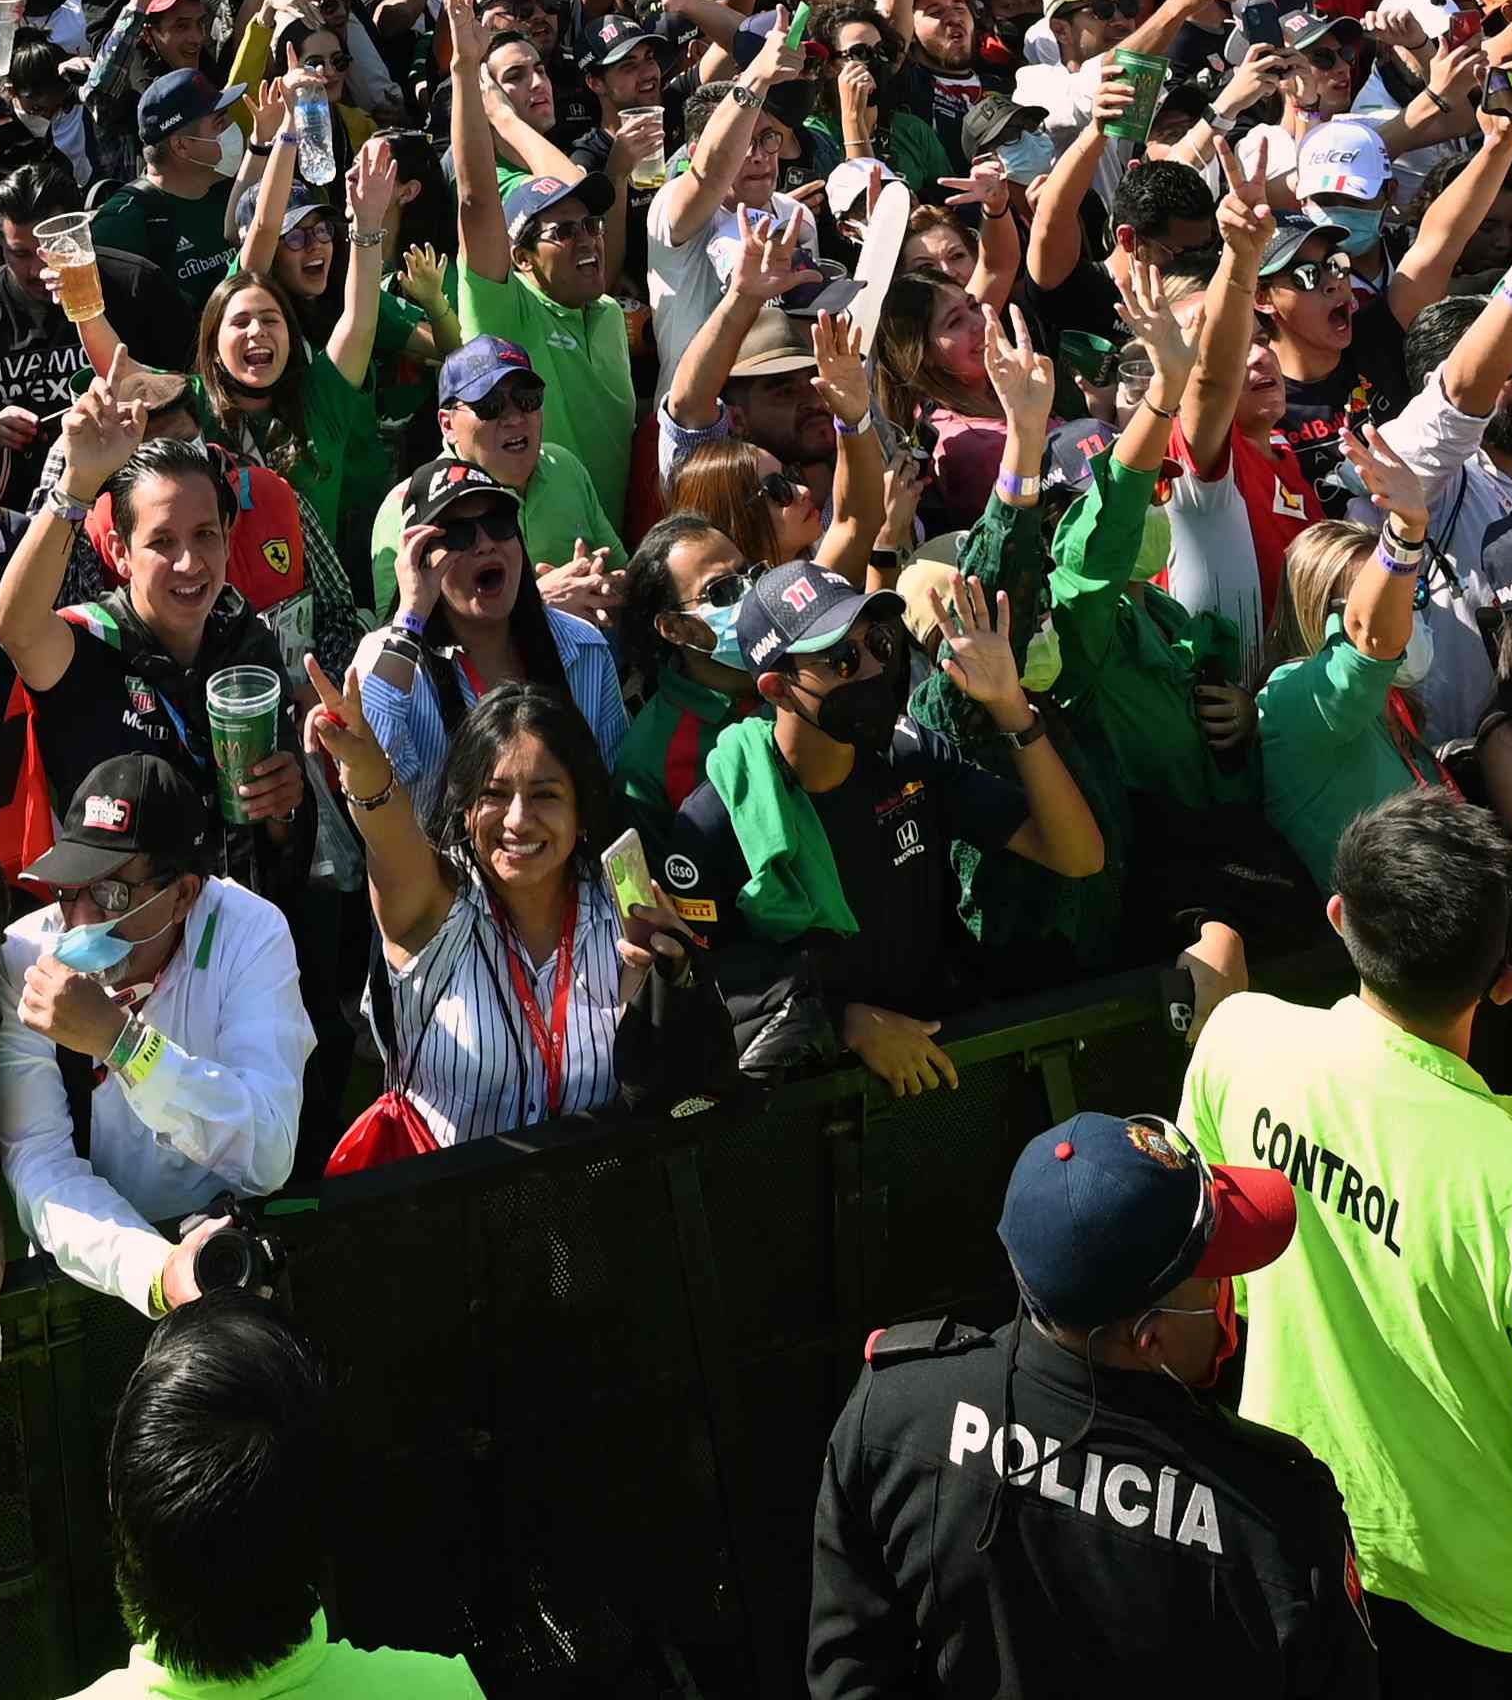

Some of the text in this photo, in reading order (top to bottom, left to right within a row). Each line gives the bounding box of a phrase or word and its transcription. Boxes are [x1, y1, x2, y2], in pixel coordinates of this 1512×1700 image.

[1309, 147, 1361, 165] telcel
[1076, 433, 1106, 459] 11
[782, 577, 818, 613] 11
[893, 845, 925, 867] HOND
[1252, 1107, 1402, 1258] CONTROL
[950, 1400, 1224, 1556] POLICÍA
